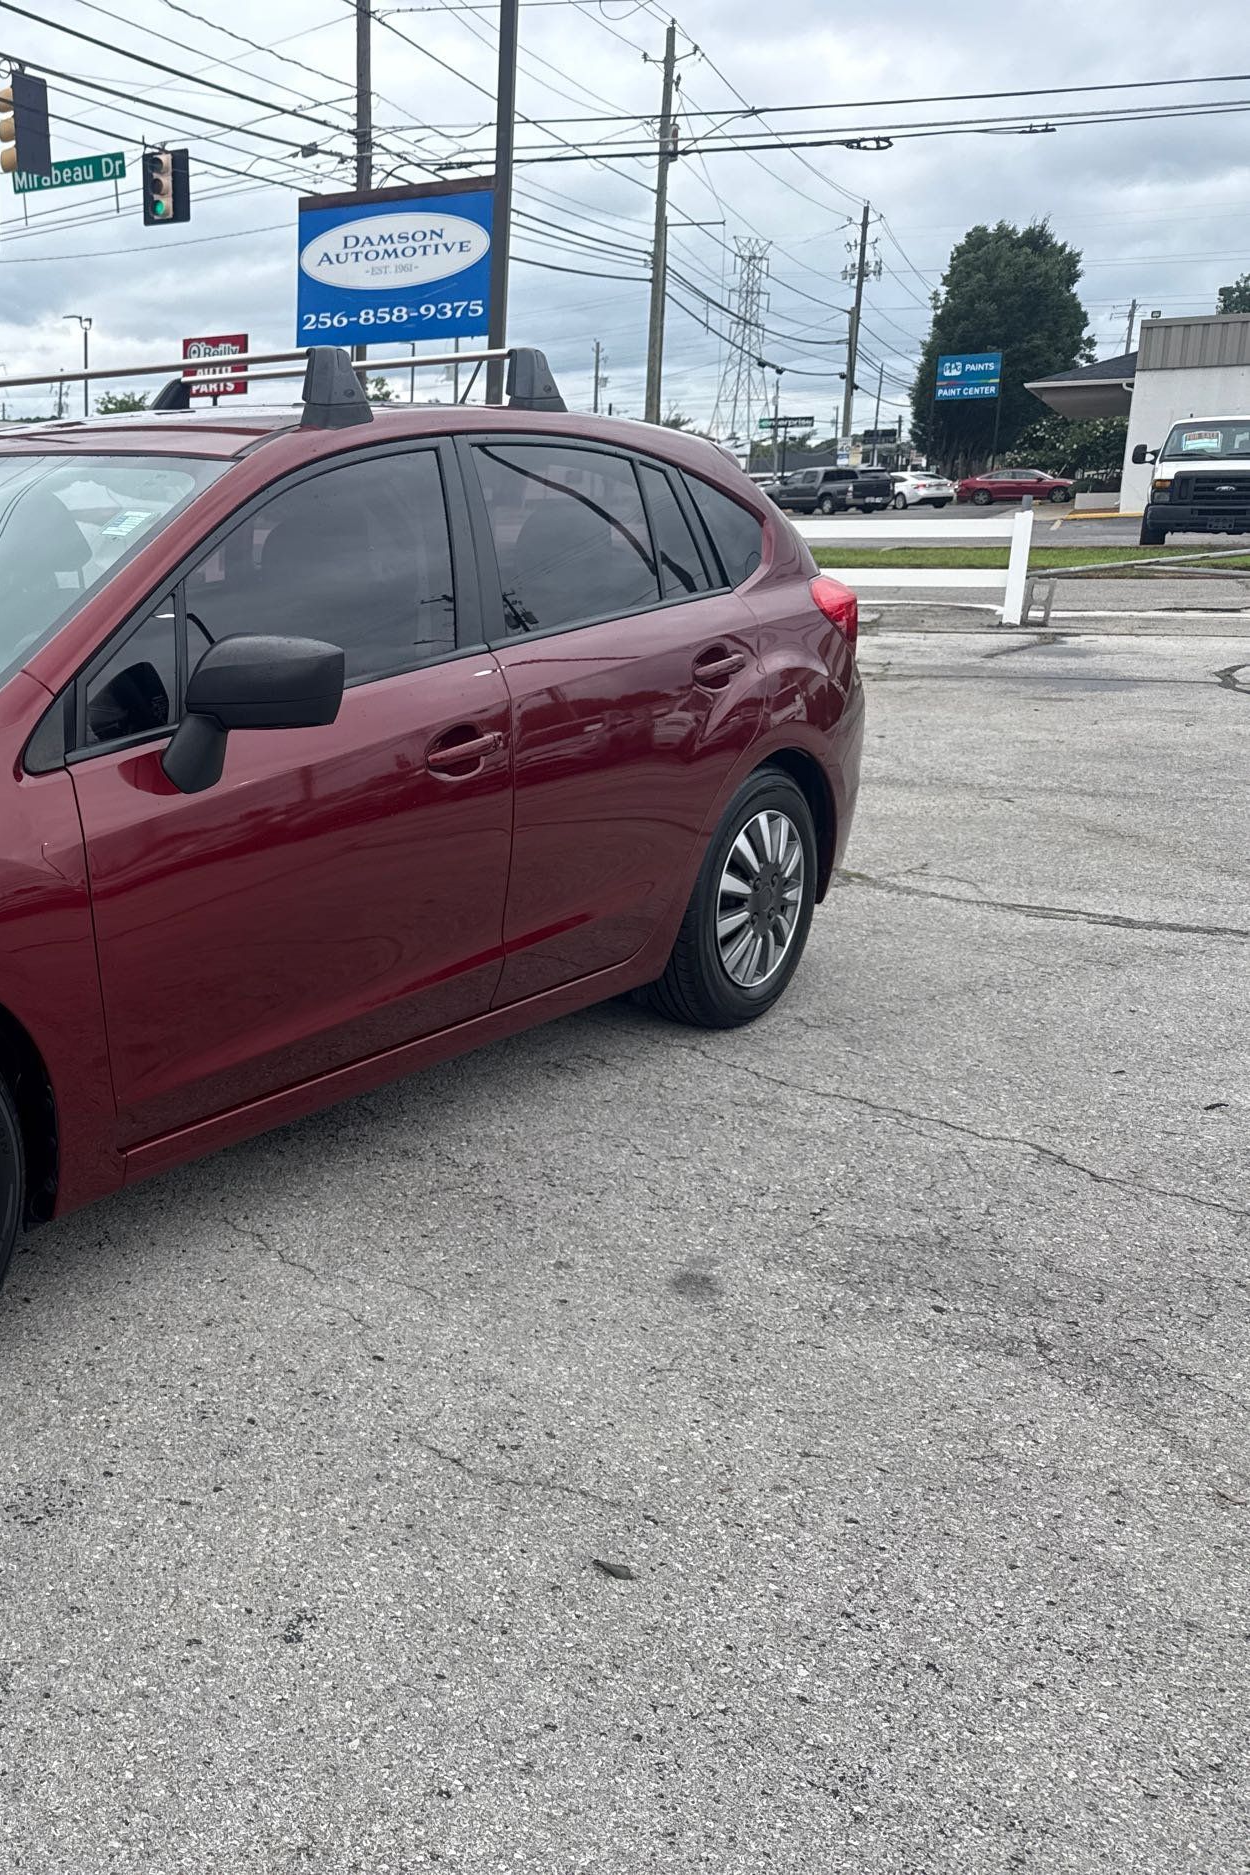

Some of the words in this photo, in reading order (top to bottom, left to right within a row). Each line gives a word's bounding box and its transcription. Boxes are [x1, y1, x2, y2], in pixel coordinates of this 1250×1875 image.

[14, 164, 94, 191] Mirabeau
[101, 158, 123, 178] Dr
[343, 228, 445, 249] DAMSON
[317, 240, 472, 266] AUTOMOTIVE
[302, 300, 484, 331] 256-858-9375
[188, 342, 240, 359] O'Reilly
[965, 363, 995, 372] PAINTS
[191, 382, 235, 394] PARTS
[937, 388, 961, 397] PAINT
[963, 386, 996, 395] CENTER
